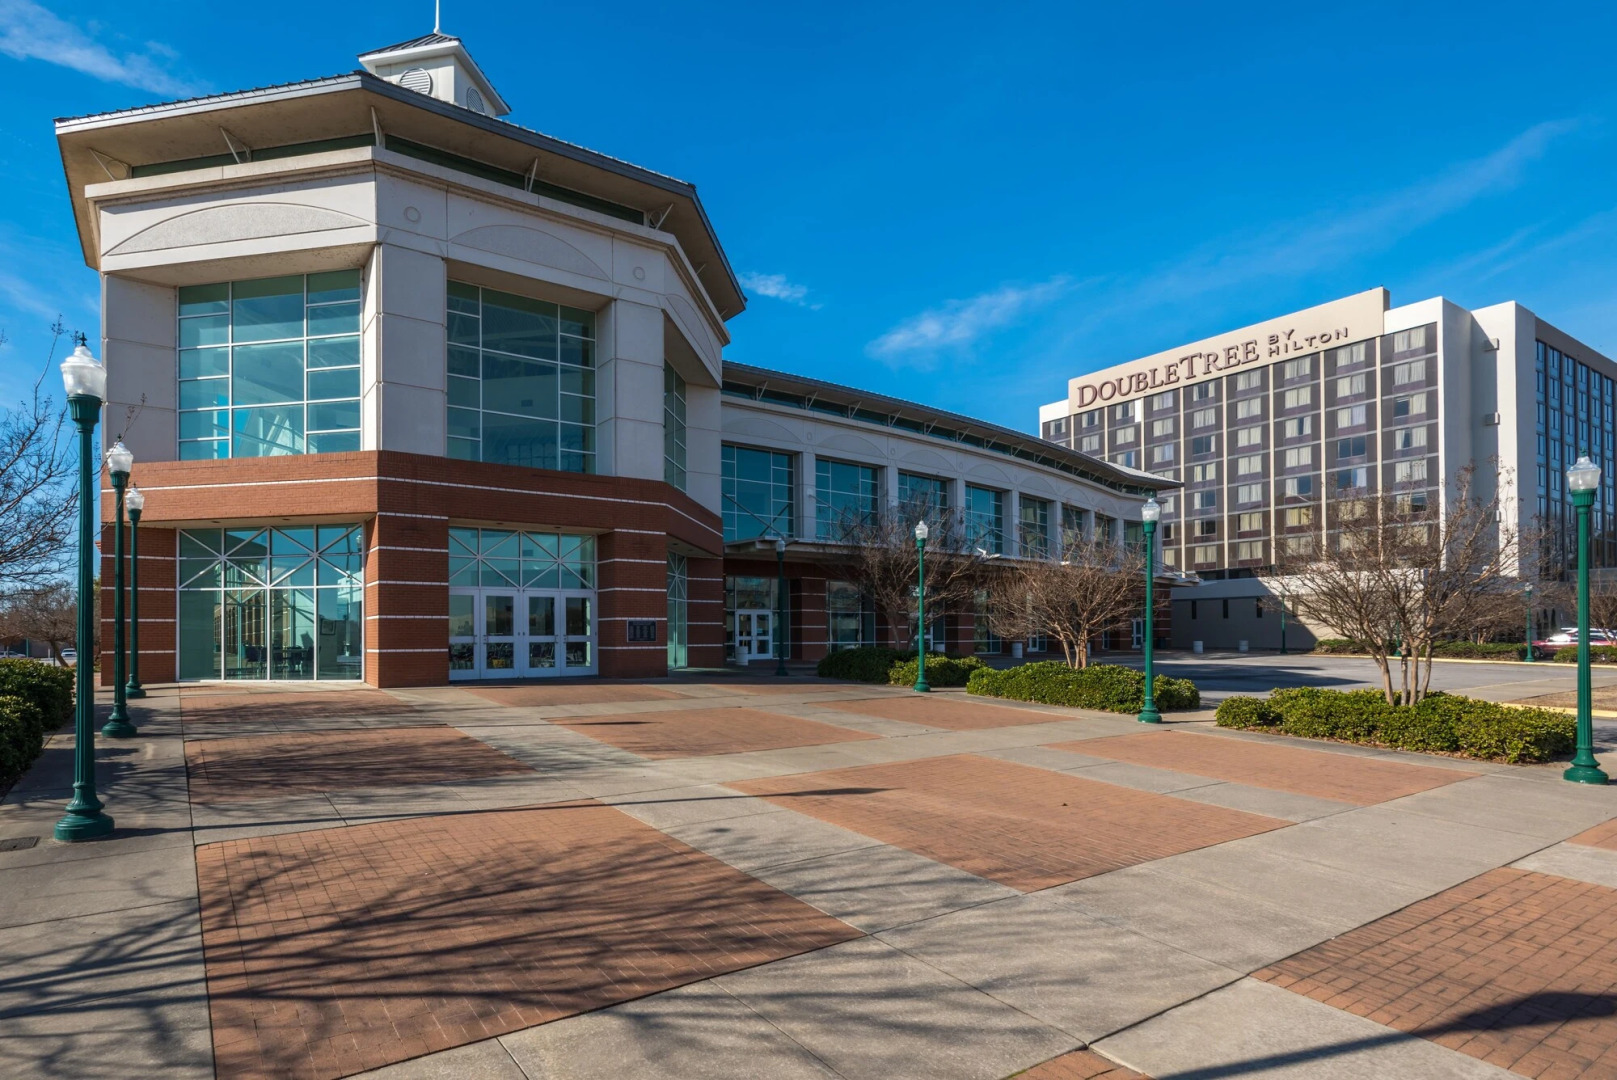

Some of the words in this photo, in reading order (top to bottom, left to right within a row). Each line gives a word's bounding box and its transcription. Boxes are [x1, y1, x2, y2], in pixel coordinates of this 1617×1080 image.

[1268, 329, 1295, 345] BY
[1268, 327, 1349, 357] HILTON
[1077, 340, 1259, 408] DOUBLETREE
